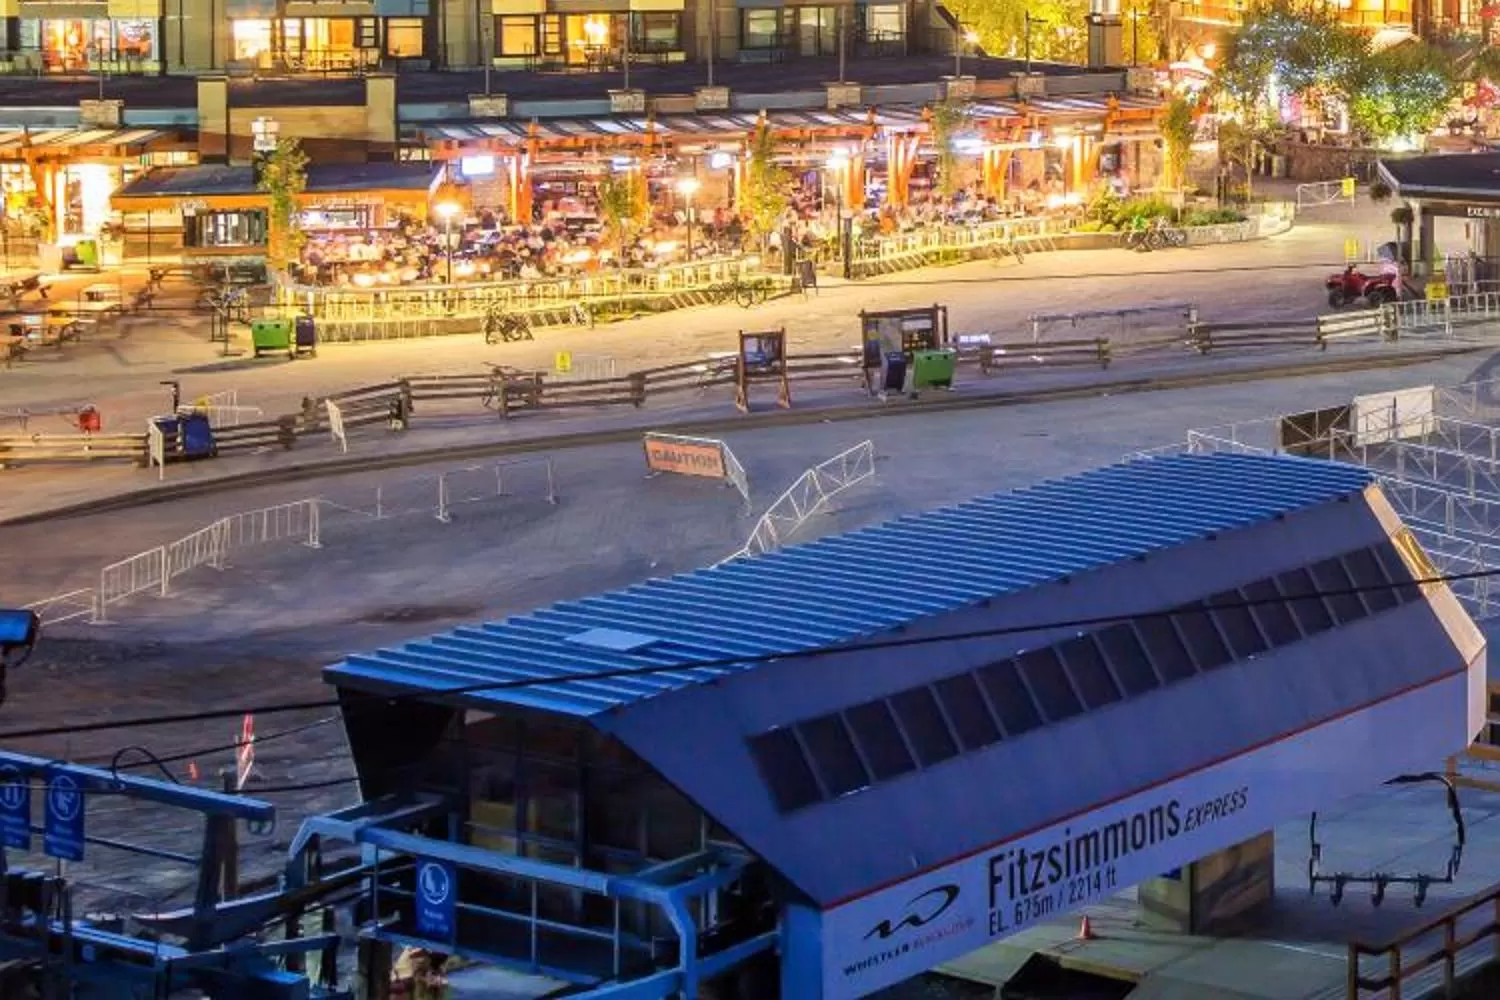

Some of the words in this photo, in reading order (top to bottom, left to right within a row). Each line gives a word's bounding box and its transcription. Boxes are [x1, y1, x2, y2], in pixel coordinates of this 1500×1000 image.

[651, 449, 718, 469] CAUTION
[988, 799, 1181, 908] Fitzsimmons
[1184, 787, 1249, 831] EXPRESS
[1015, 896, 1053, 926] 675m
[1068, 872, 1101, 905] 2214
[1105, 866, 1117, 890] ft
[843, 943, 910, 977] WHISTLER
